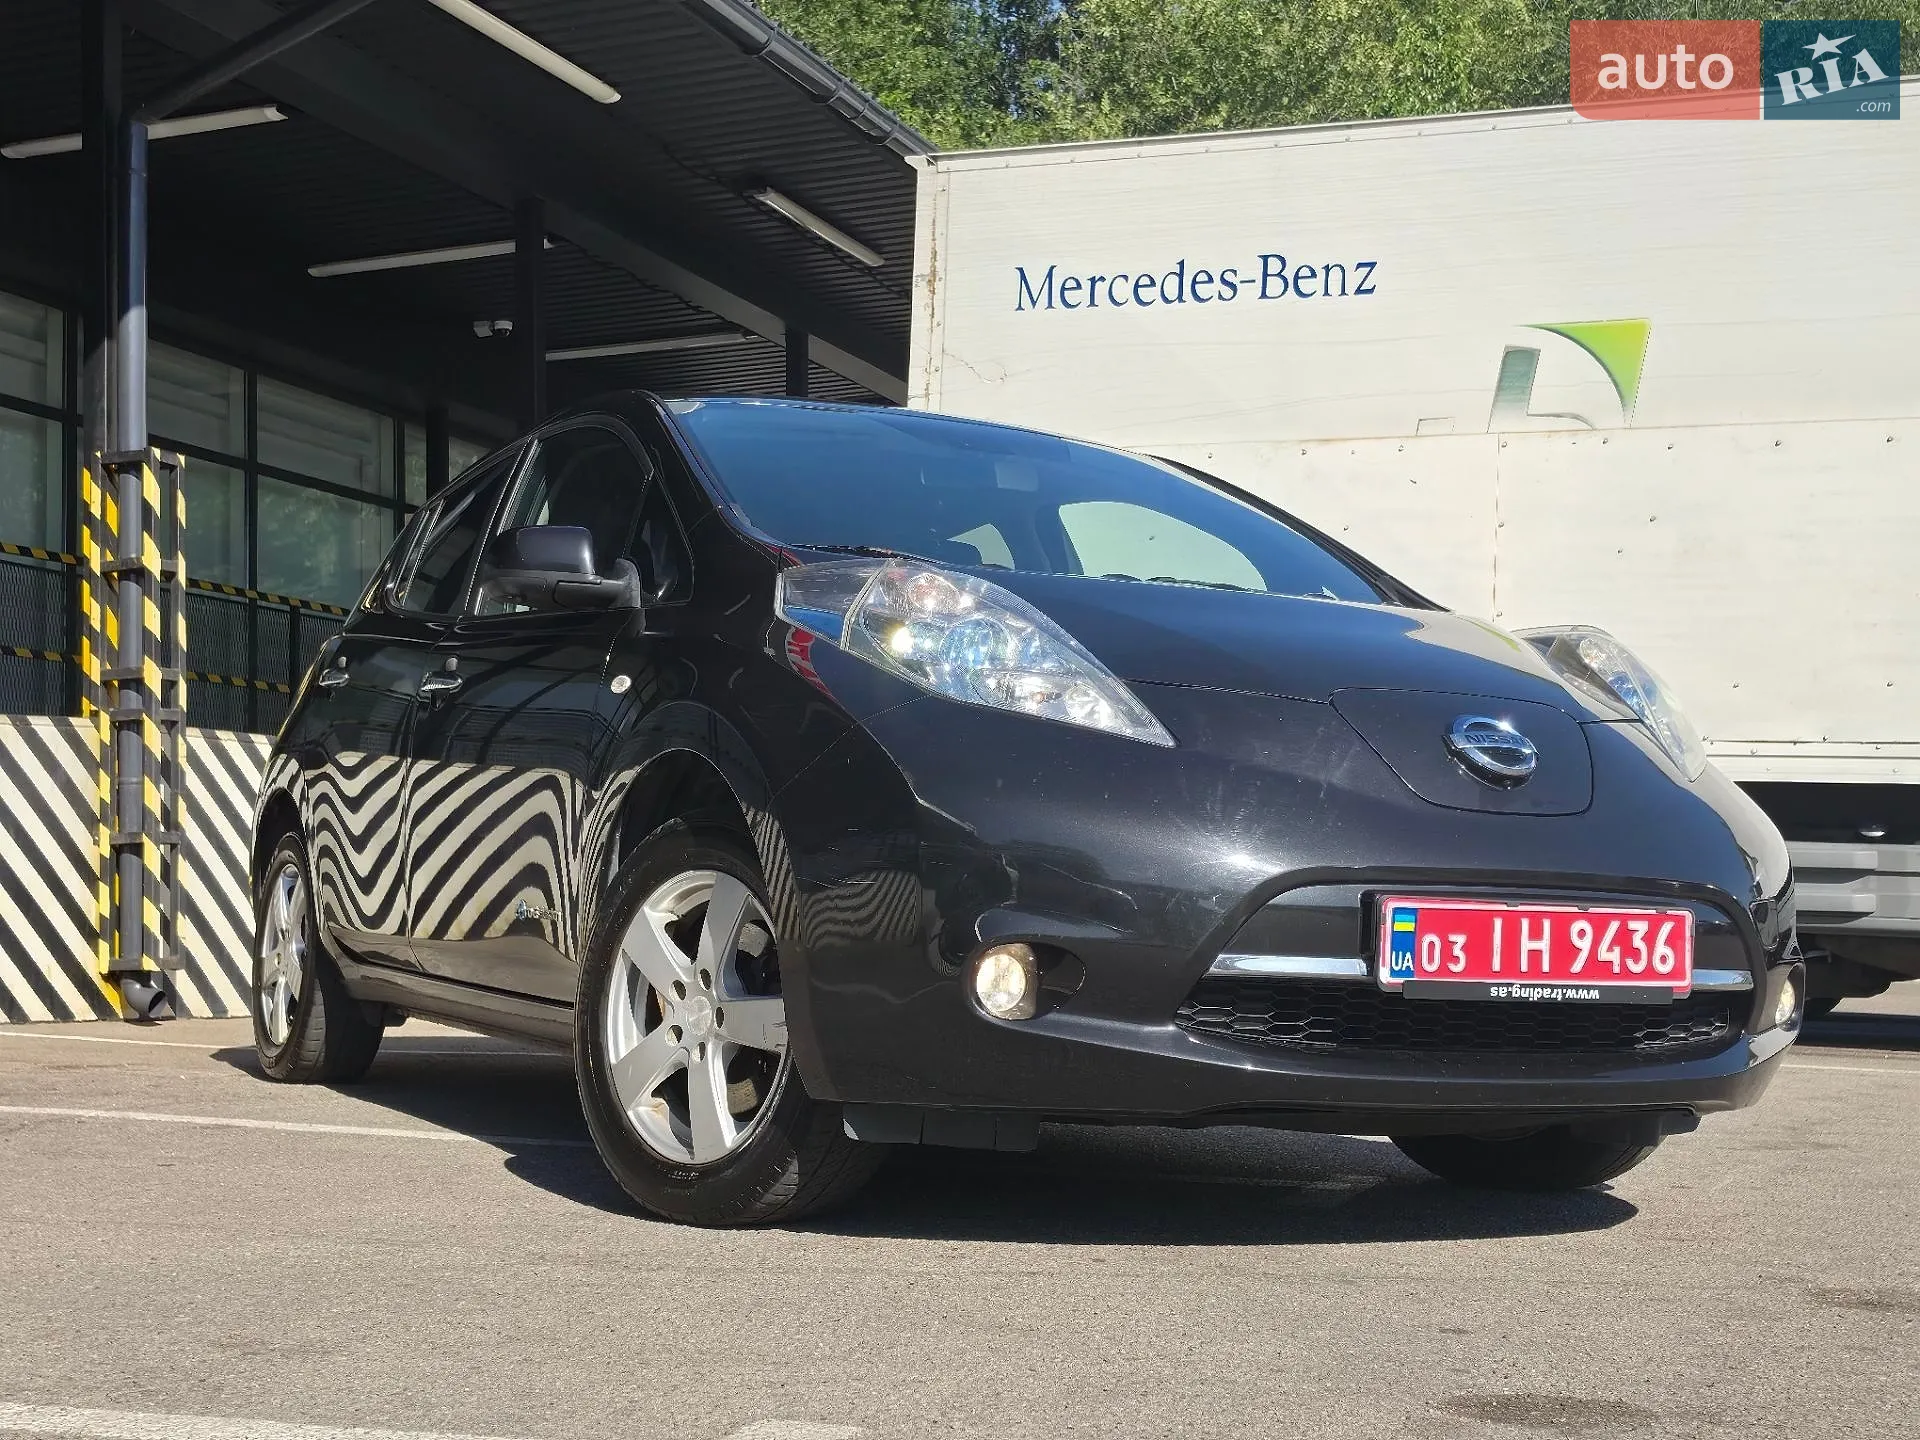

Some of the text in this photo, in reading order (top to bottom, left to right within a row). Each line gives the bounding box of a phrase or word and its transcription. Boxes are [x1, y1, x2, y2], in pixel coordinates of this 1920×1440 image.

[1014, 252, 1379, 312] Mercedes-Benz
[1391, 955, 1415, 972] UA
[1420, 917, 1676, 975] 03 IH 9436
[1489, 984, 1601, 1000] www.trading.as
